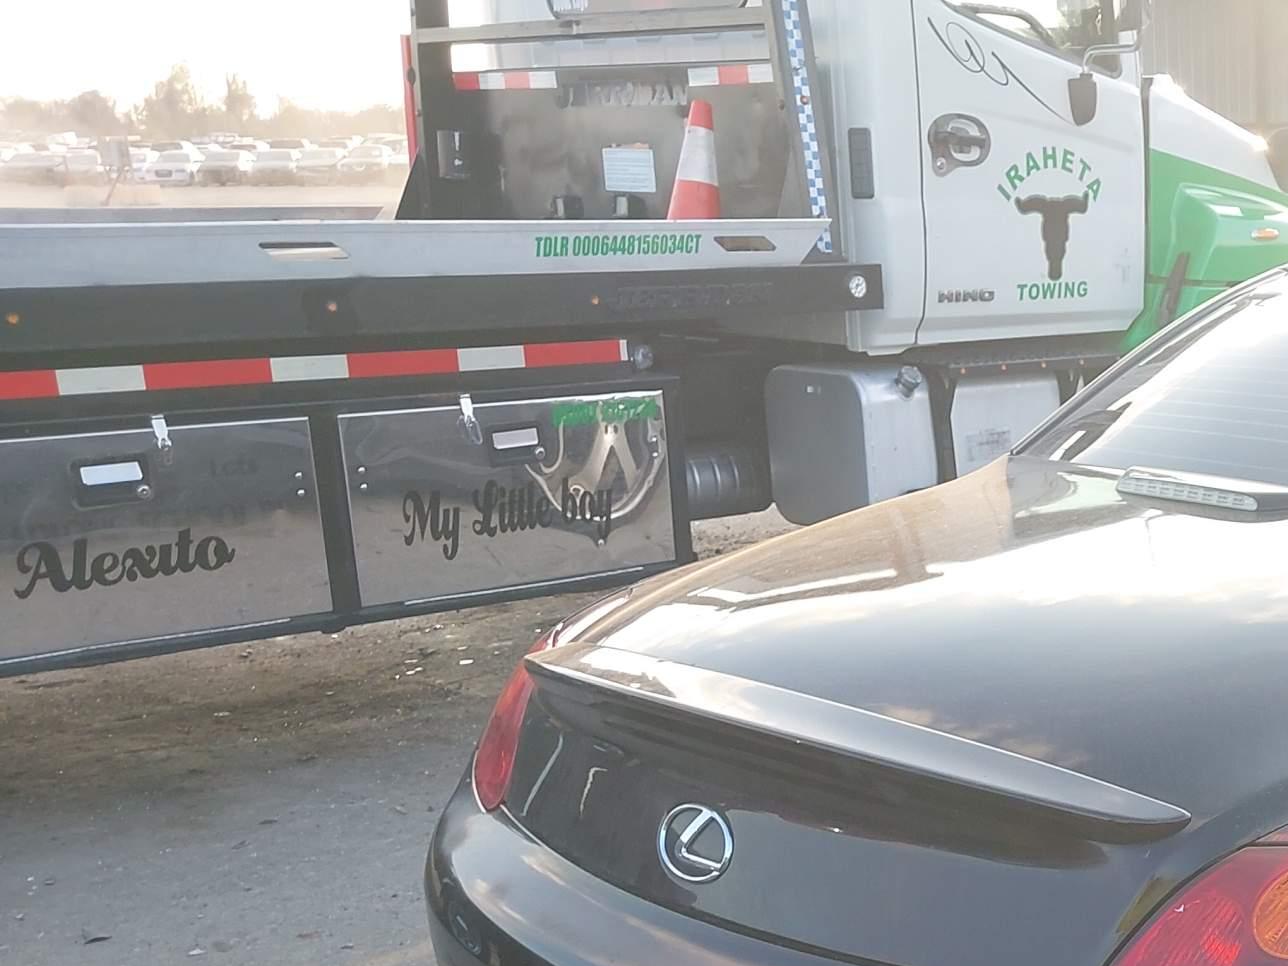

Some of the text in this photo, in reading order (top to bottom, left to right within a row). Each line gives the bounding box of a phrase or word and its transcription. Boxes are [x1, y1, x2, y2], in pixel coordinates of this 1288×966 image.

[997, 146, 1101, 202] IRAHETA
[535, 234, 702, 257] TDLR 0006448156034CT
[938, 289, 995, 303] HINO
[1017, 281, 1088, 301] TOWING
[402, 490, 460, 560] My
[561, 476, 612, 546] boy
